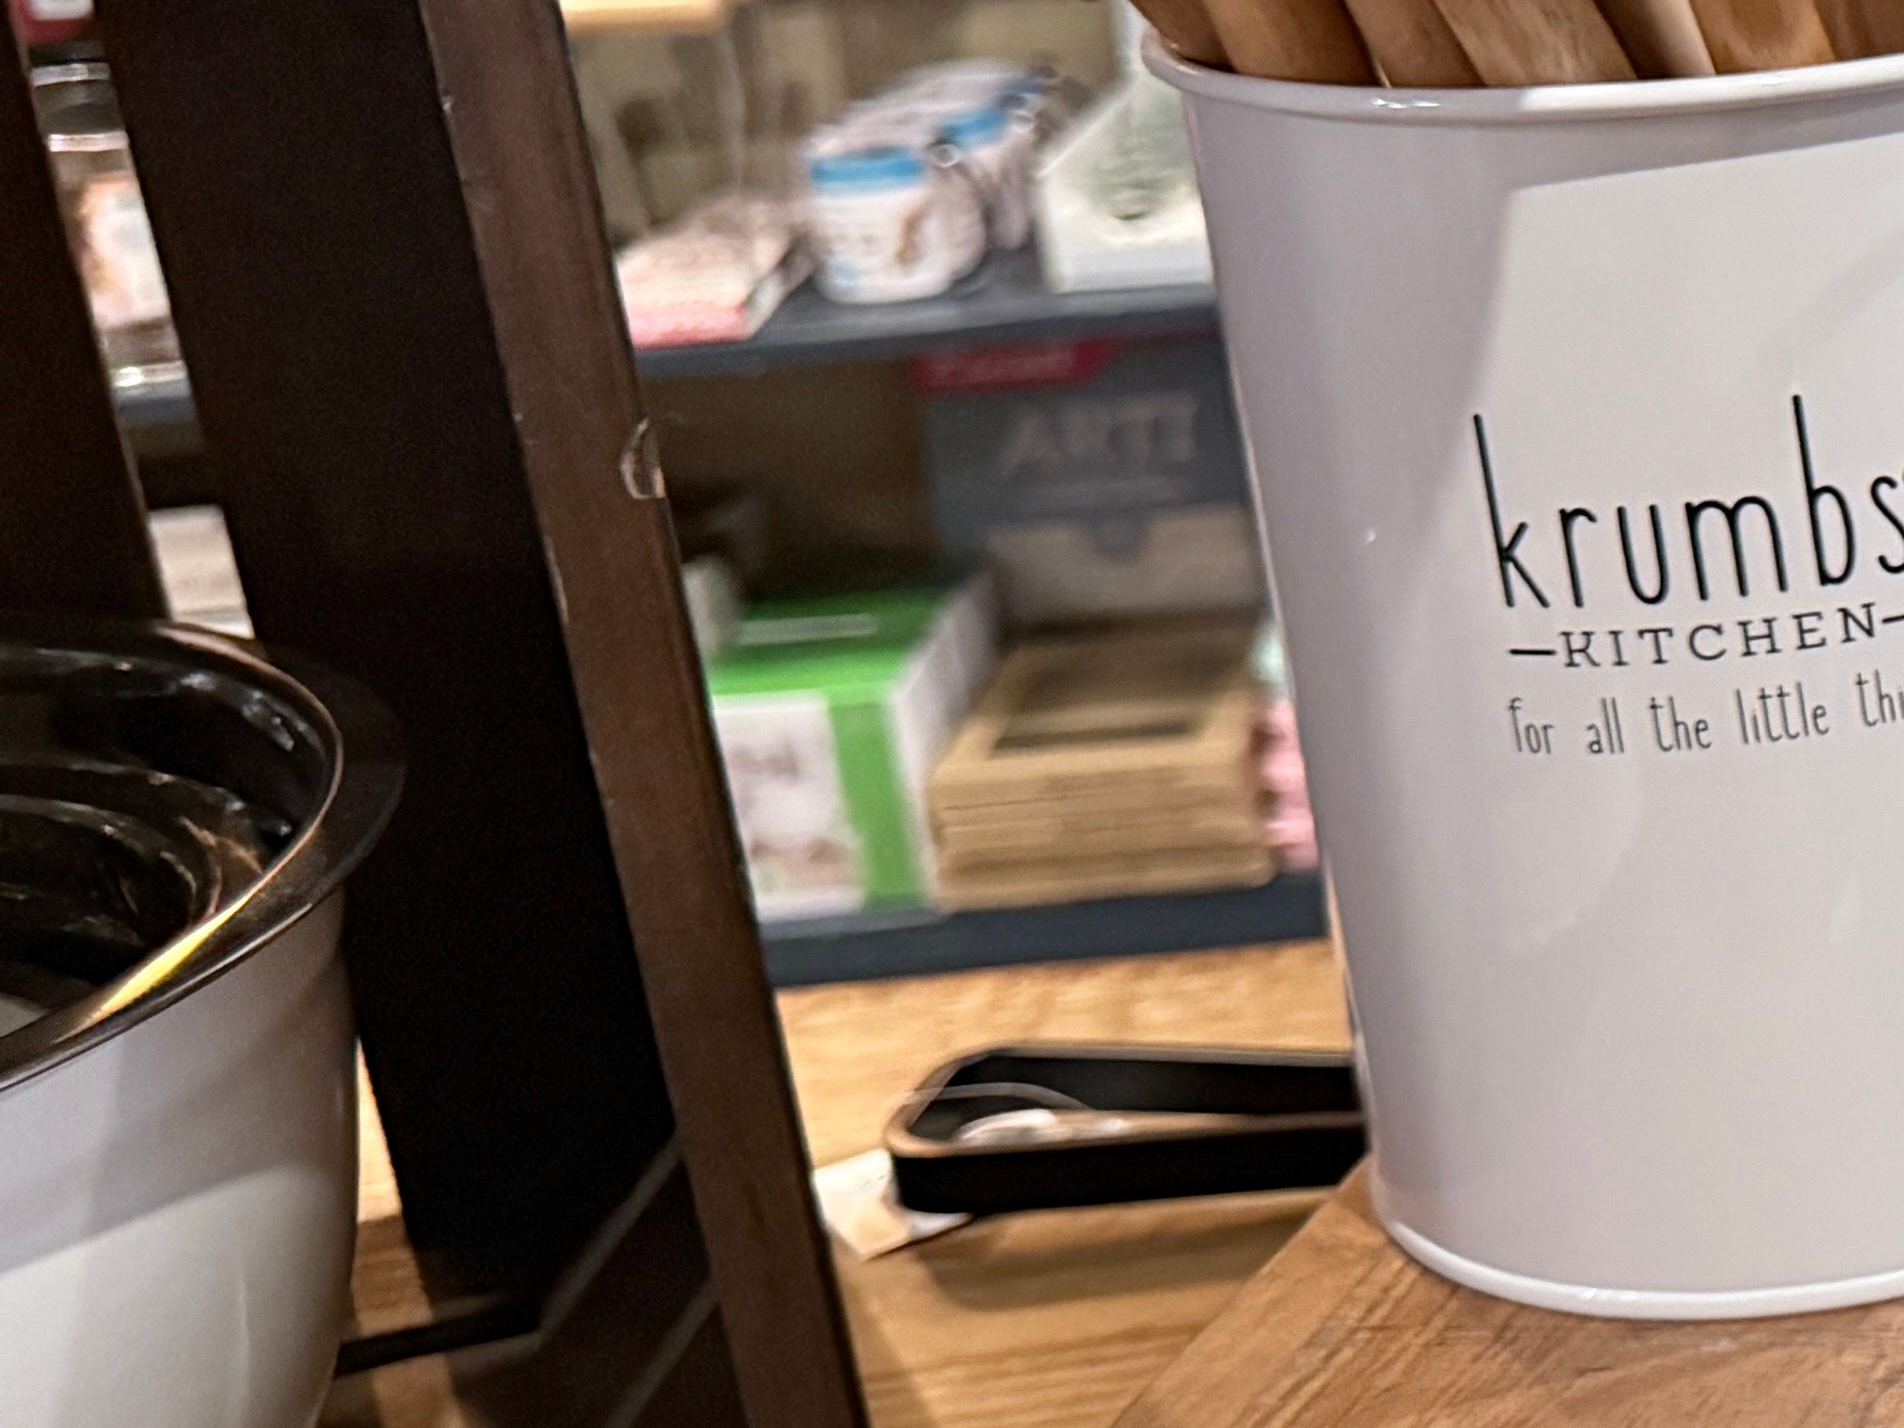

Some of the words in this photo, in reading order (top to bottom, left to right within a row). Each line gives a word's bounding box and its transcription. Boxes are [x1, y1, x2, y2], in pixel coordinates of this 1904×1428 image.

[1560, 602, 1877, 668] KITCHEN
[1507, 696, 1555, 755] for
[1586, 697, 1625, 755] all
[1649, 695, 1713, 754] the
[1735, 681, 1830, 747] little
